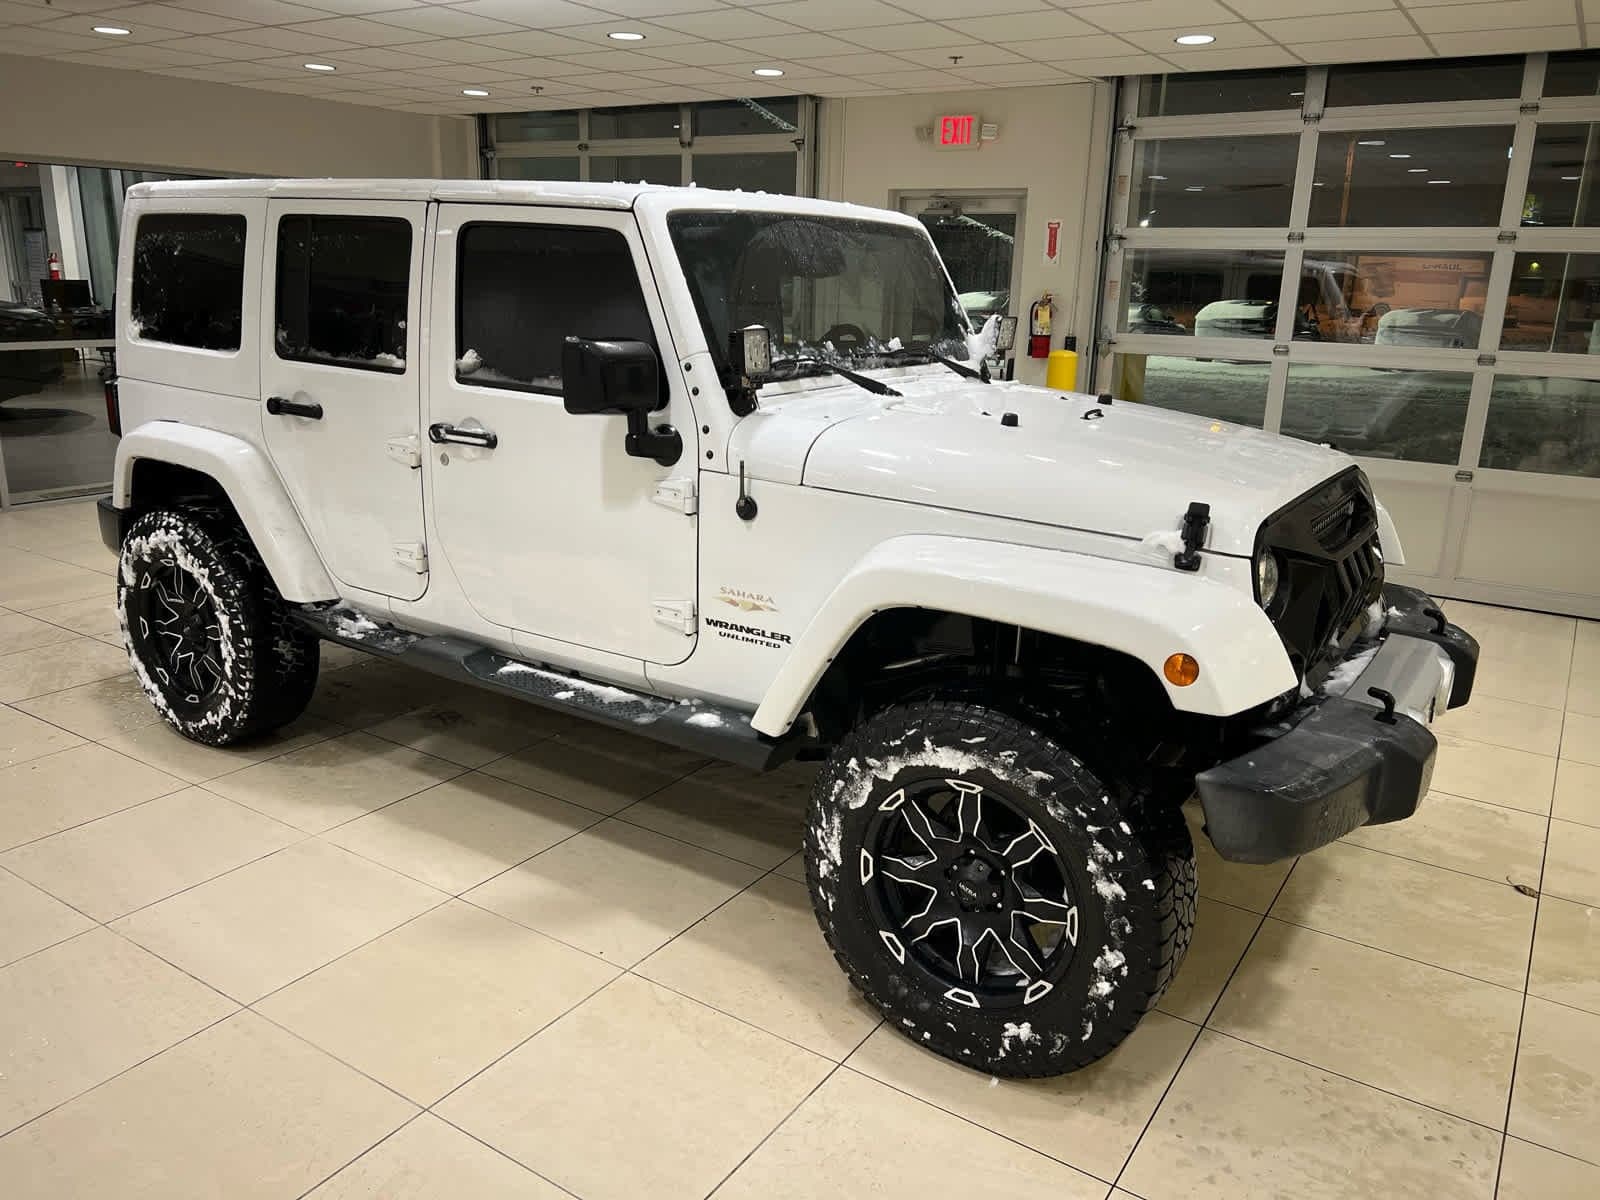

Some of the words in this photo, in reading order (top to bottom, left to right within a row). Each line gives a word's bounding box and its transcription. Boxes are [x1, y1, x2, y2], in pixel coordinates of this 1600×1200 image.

[941, 115, 974, 145] EXIT
[720, 586, 775, 604] SAHARA
[705, 617, 792, 644] WRANGLER
[718, 631, 781, 649] UNLIMITED
